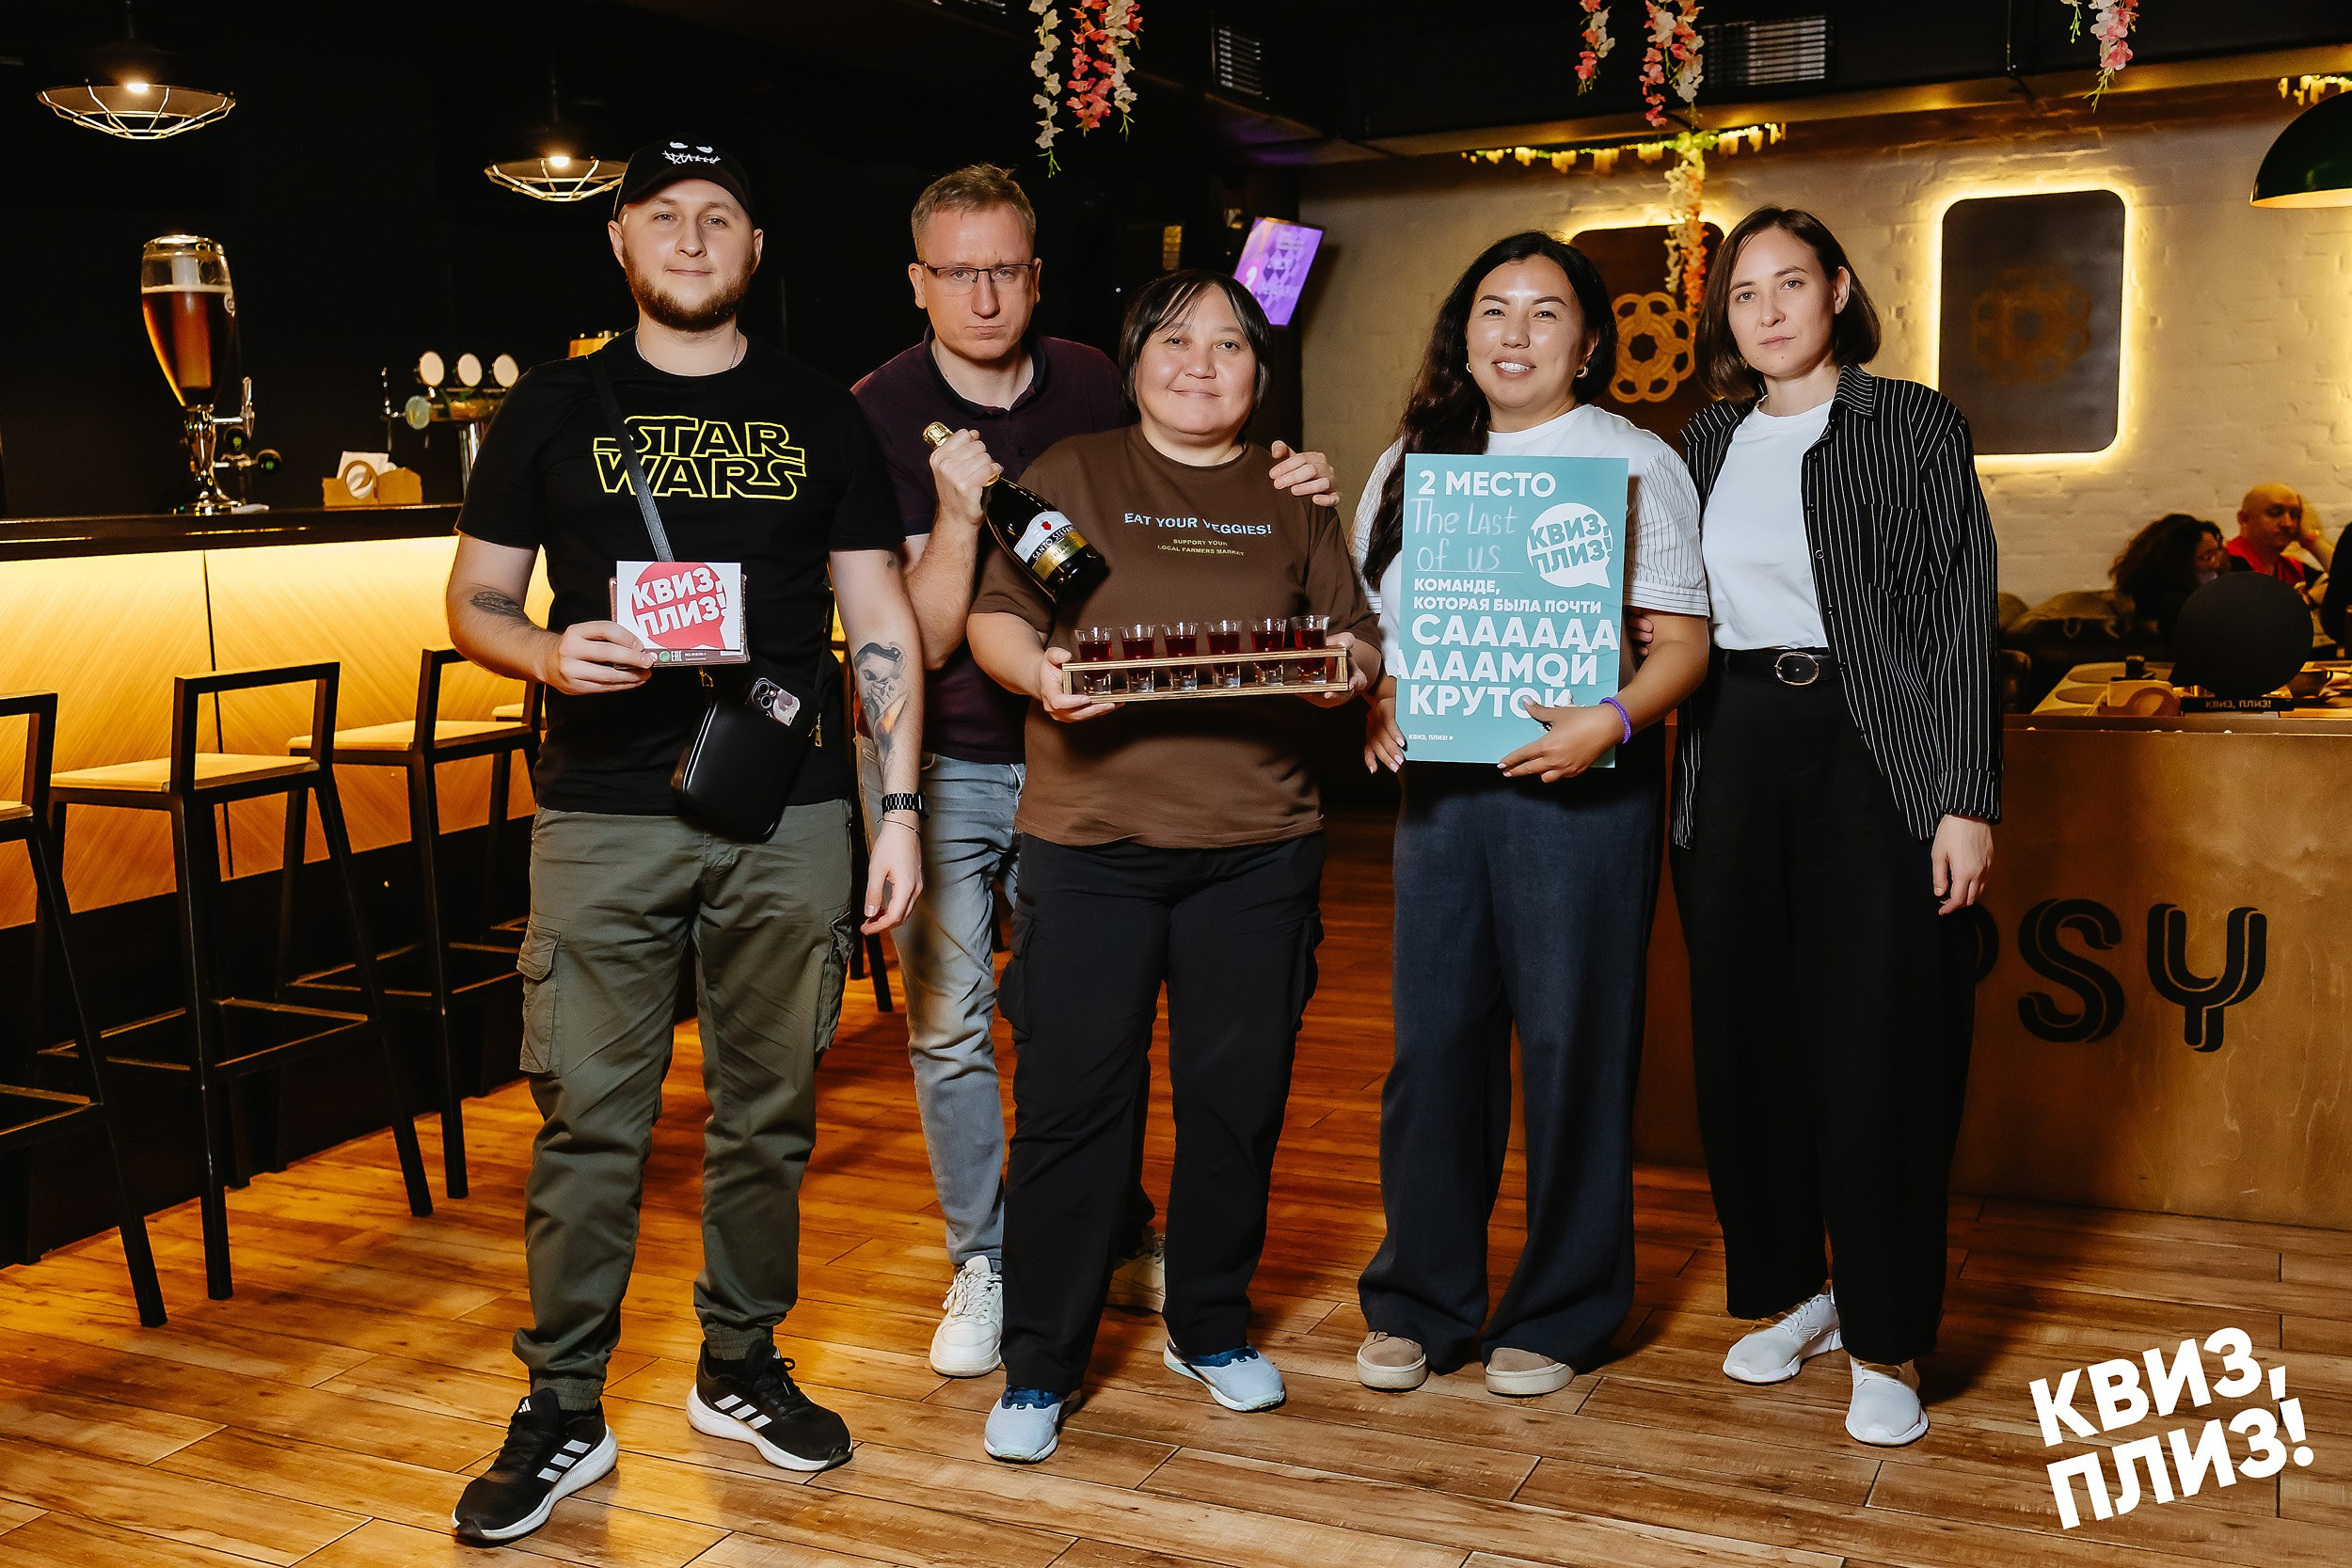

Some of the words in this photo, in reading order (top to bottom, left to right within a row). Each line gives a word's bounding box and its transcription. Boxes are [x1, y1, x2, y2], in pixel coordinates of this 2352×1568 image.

[593, 415, 805, 463] STAR
[594, 451, 806, 500] WARS
[1418, 470, 1436, 495] 2
[1446, 470, 1556, 498] МЕСТО
[1124, 513, 1152, 526] EAT
[1155, 517, 1198, 528] YOUR
[1202, 518, 1272, 535] VEGGIES!
[1408, 498, 1460, 533] The
[1032, 538, 1054, 561] SANTO
[632, 567, 723, 610] КВИЗ,
[1414, 578, 1501, 595] КОМАНДЕ,
[635, 593, 726, 638] ПЛИЗ!
[1413, 596, 1490, 611] КОТОРАЯ
[1493, 599, 1541, 613] БЫЛА
[1545, 600, 1601, 614] ПОЧТИ
[1411, 613, 1619, 651] САААААА
[2205, 700, 2235, 709] КВИЗ,
[2239, 699, 2271, 708] ПЛИЗ!
[1975, 898, 2267, 1053] SY
